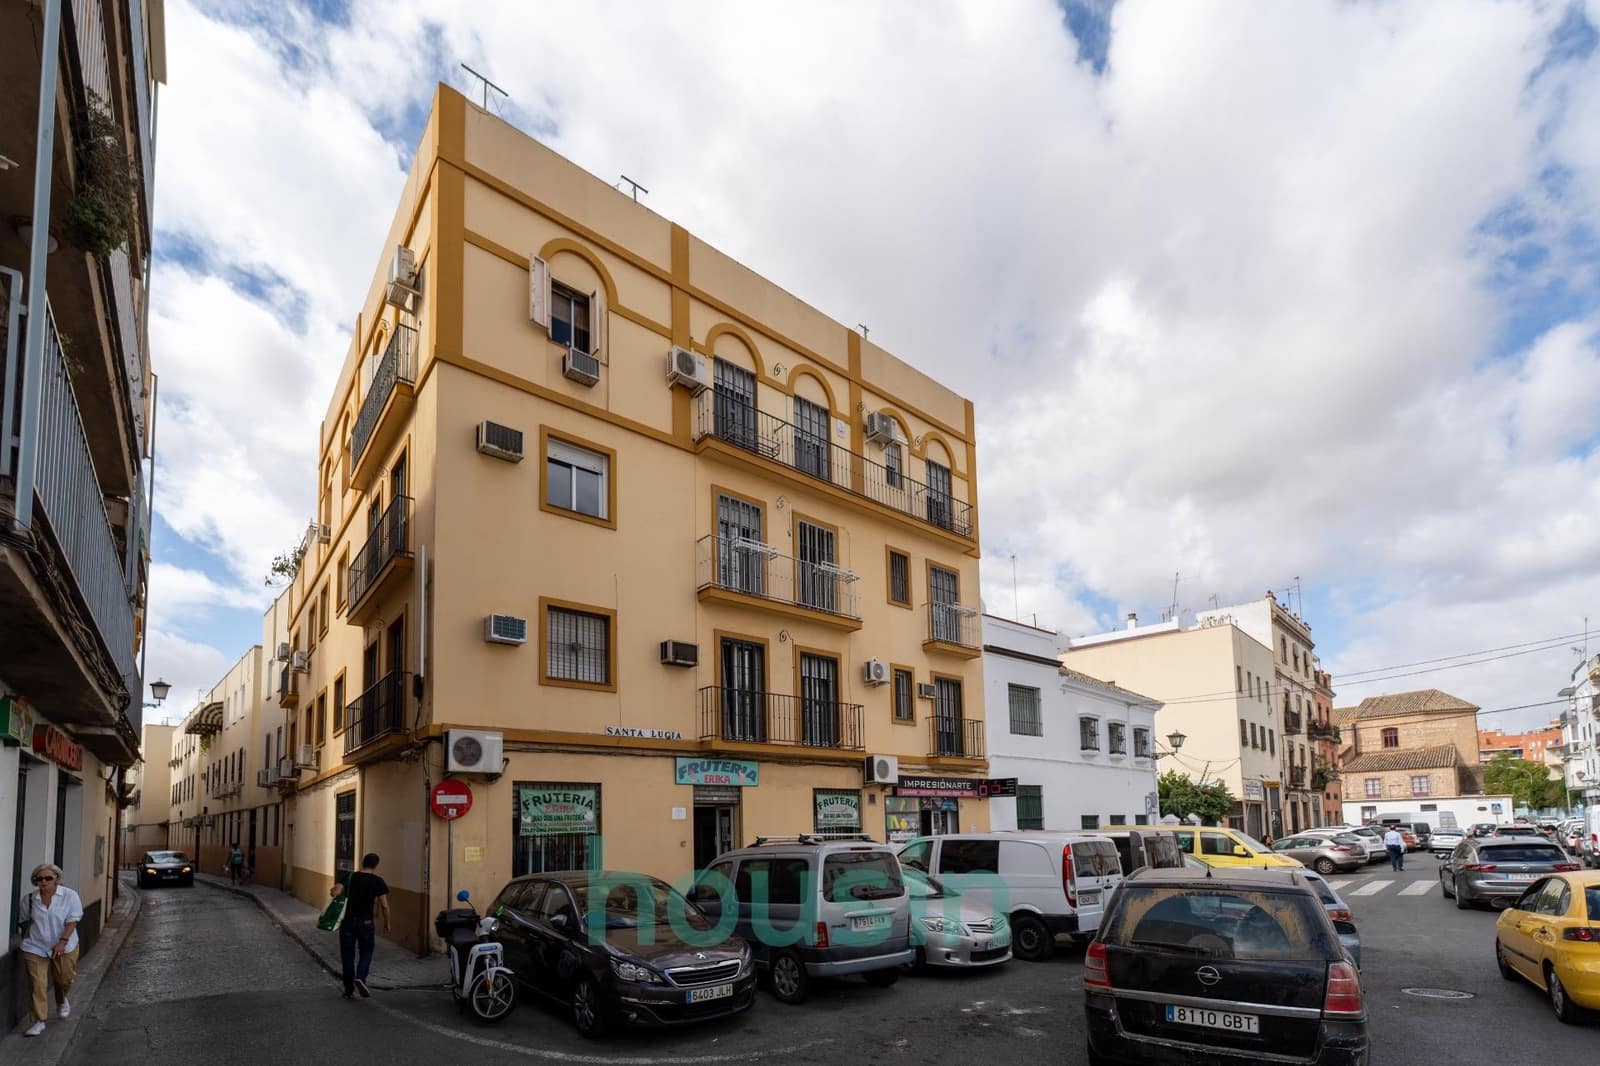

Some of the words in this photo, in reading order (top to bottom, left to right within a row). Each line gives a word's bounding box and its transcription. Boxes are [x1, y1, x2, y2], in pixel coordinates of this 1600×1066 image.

[606, 727, 644, 737] SANTA
[678, 760, 757, 783] FRUTERIA
[703, 774, 731, 784] ERIKA
[522, 792, 594, 811] FRUTERIA
[817, 796, 858, 811] FRUTERIA
[692, 989, 714, 1001] 6403
[716, 985, 732, 997] JLH
[1177, 1008, 1217, 1025] 8110
[1223, 1014, 1254, 1030] GBT
